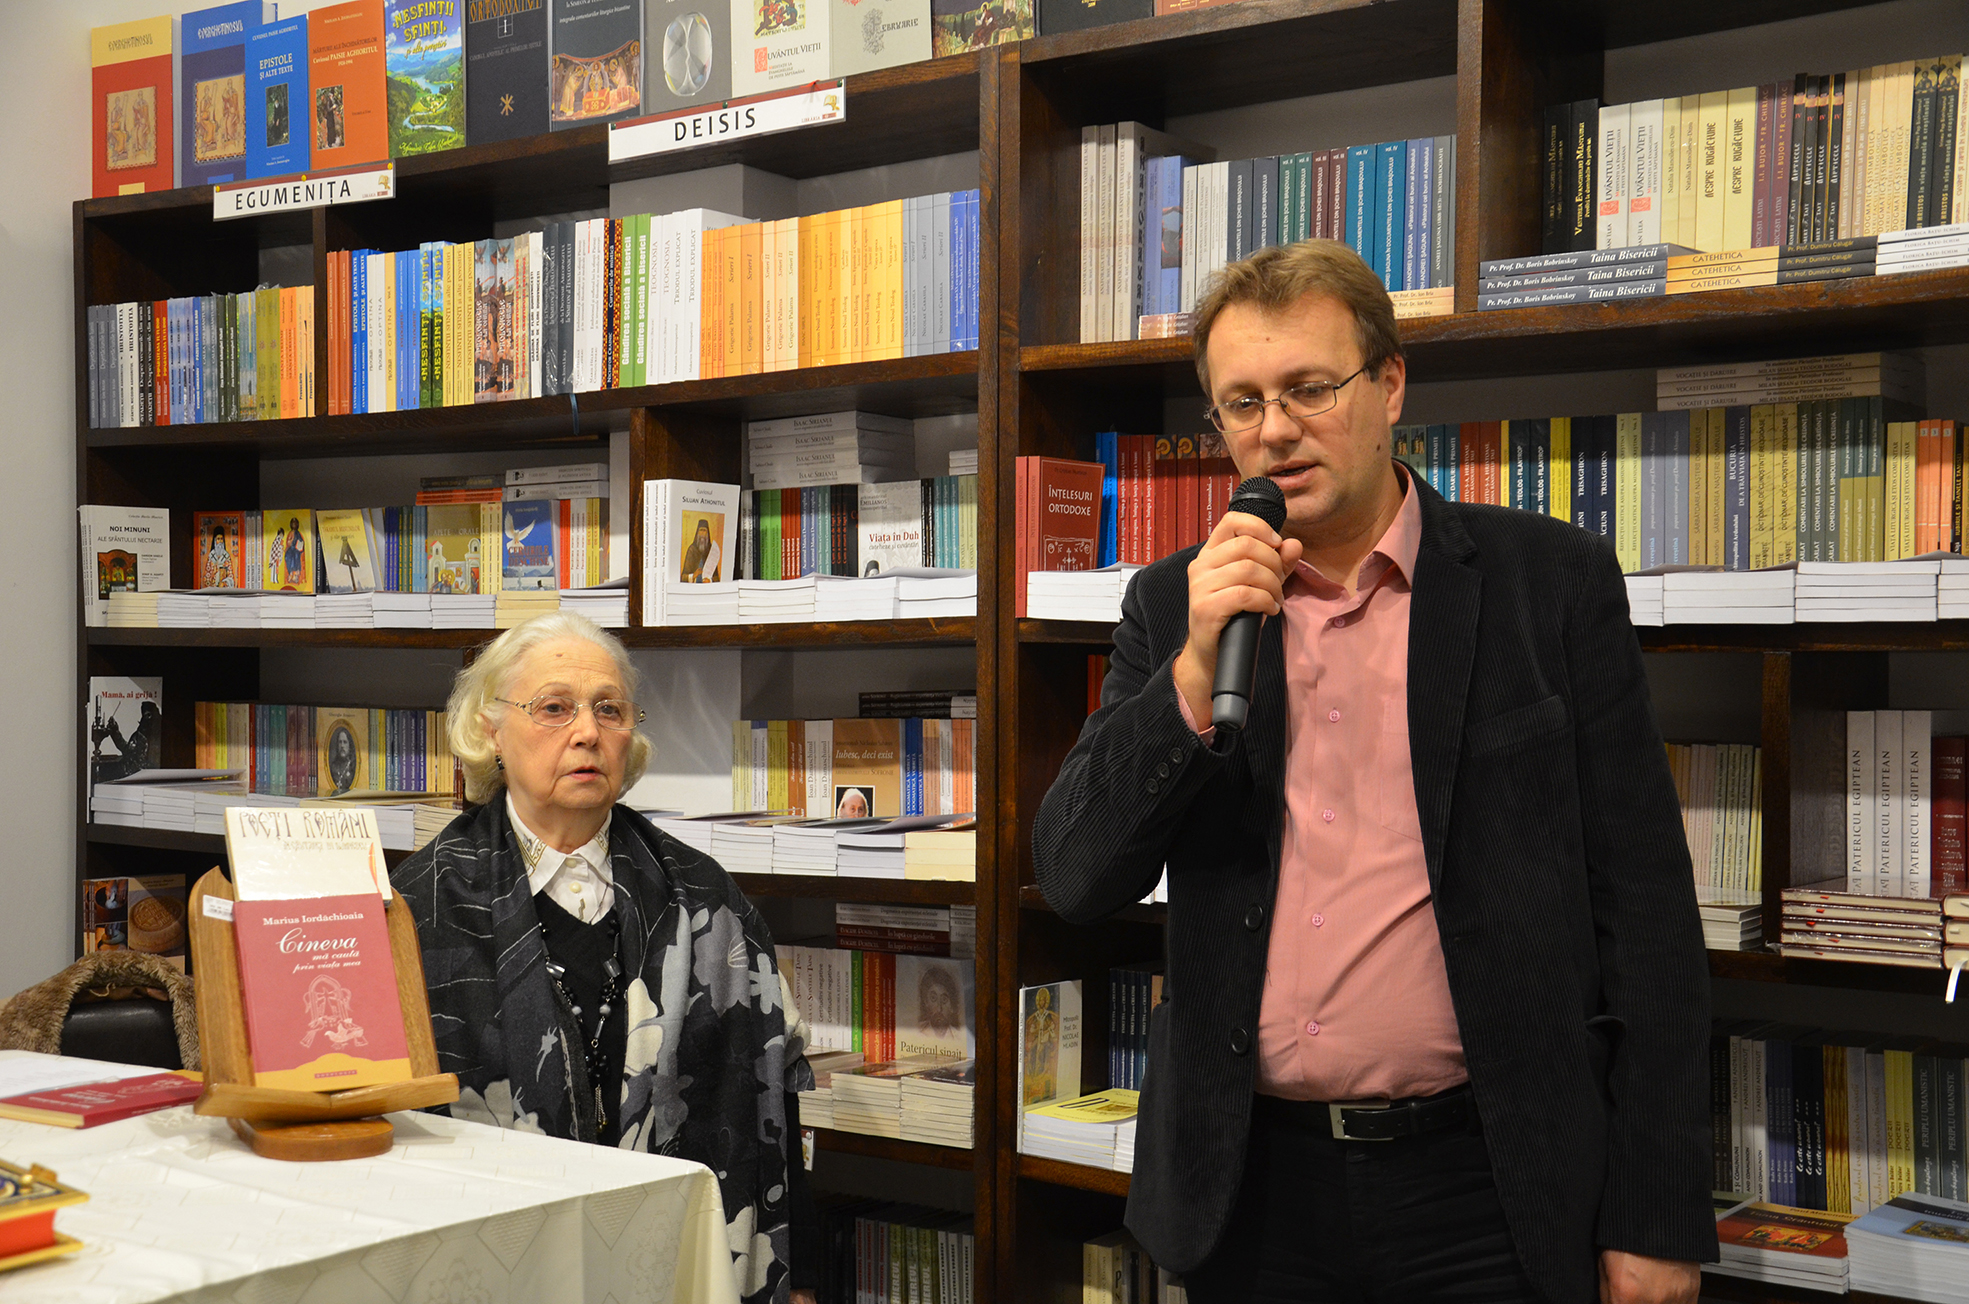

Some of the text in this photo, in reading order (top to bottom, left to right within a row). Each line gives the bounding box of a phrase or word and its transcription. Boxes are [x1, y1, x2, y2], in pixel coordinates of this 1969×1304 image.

[260, 53, 292, 70] EPISTOLE
[266, 68, 278, 78] ALTE
[278, 65, 293, 76] TEXTE
[674, 108, 756, 142] DEISIS
[1606, 130, 1614, 156] VIEȚII
[235, 179, 351, 210] EGUMENIȚA
[622, 236, 632, 276] Bisericii
[1500, 262, 1514, 272] Prof.
[1526, 259, 1542, 268] Boris
[1544, 257, 1578, 268] Bobrinskoy
[1590, 252, 1616, 263] Taina
[1618, 246, 1658, 260] Bisericii
[1692, 252, 1742, 262] CATEHETICA
[622, 323, 630, 365] Gândirea
[1048, 484, 1093, 502] ÎNȚELESURI
[1802, 488, 1807, 496] LA
[1048, 503, 1091, 516] ORTODOXE
[870, 531, 920, 544] Viața în Duh
[508, 556, 550, 566] DESCHISE
[806, 740, 814, 786] Damaschinul
[836, 750, 894, 760] Iubesc, deci exist
[1852, 750, 1862, 872] PATERICUL EGIPTEAN
[263, 912, 364, 926] Marius Iordăchioaia
[276, 928, 358, 954] Cineva
[332, 950, 360, 960] caută
[293, 962, 315, 974] prin
[342, 960, 361, 968] mea
[901, 1040, 938, 1054] Patericul
[1920, 1068, 1930, 1148] PERIPLU UMANISTIC
